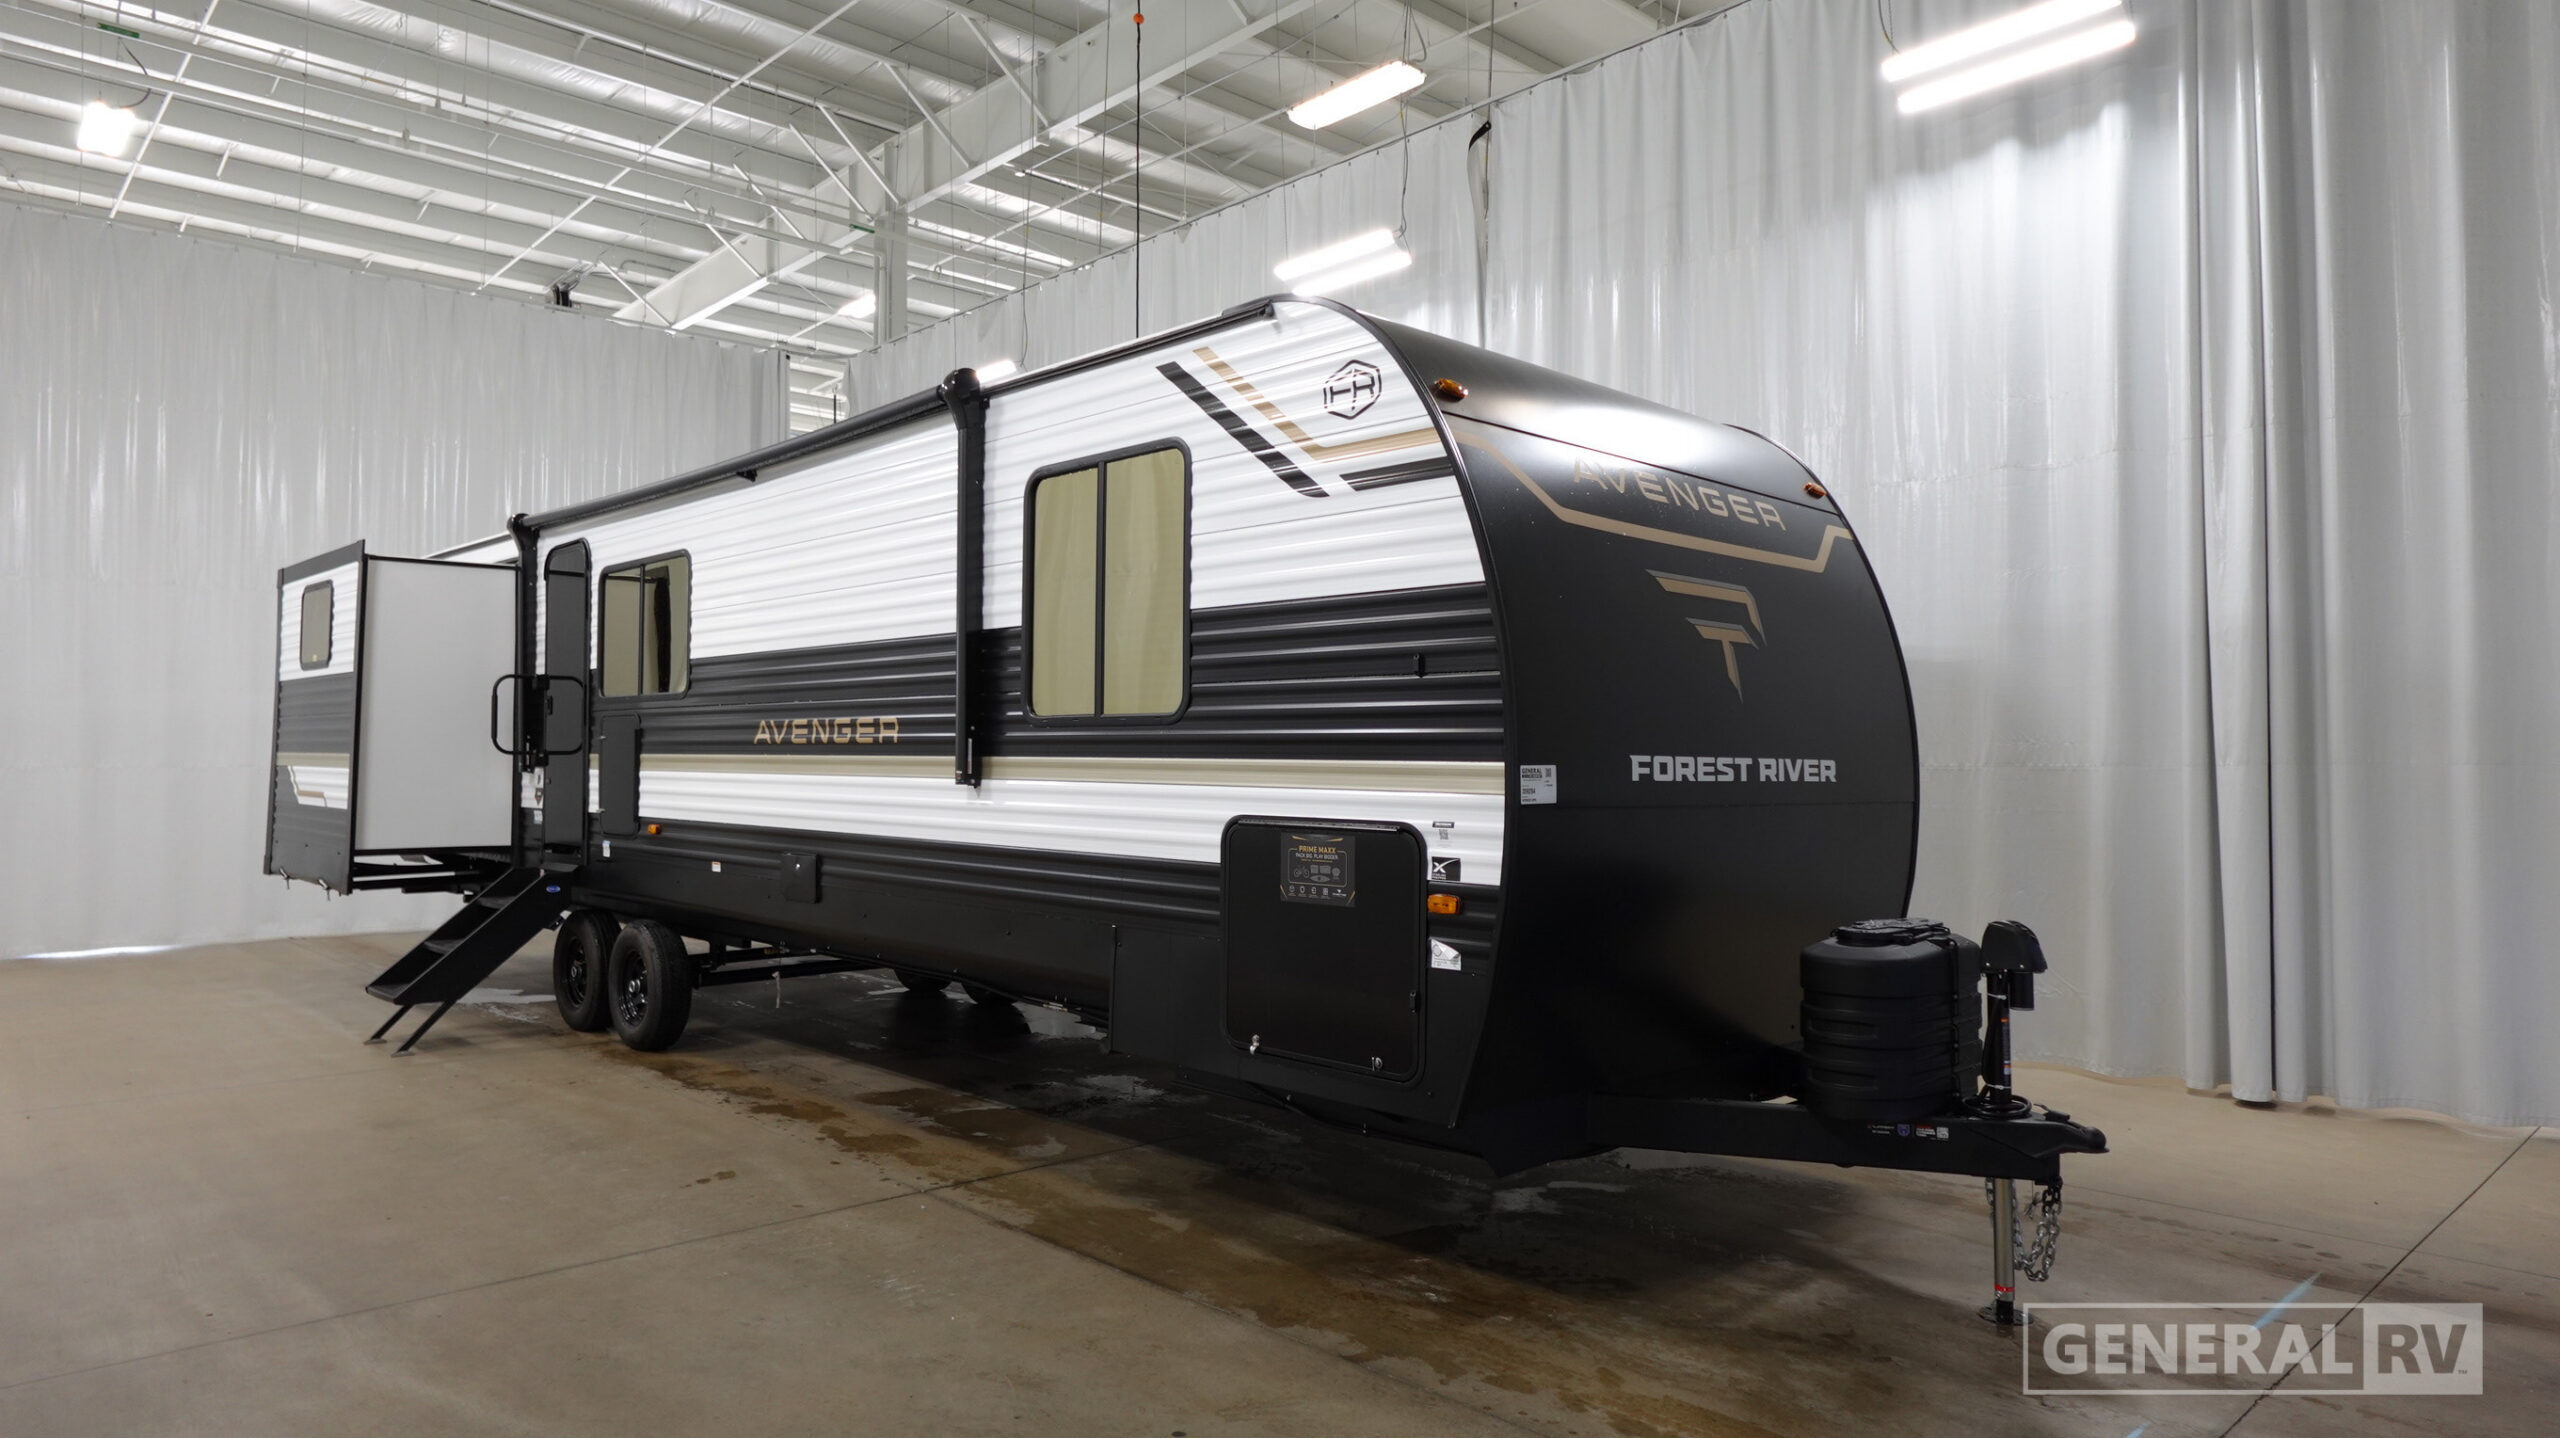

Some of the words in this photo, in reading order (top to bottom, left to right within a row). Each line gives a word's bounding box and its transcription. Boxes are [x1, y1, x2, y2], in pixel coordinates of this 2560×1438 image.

[1573, 457, 1787, 531] AVENGER
[754, 717, 899, 745] AVENGER
[1629, 755, 1753, 782] FOREST
[1757, 758, 1837, 783] RIVER
[1298, 845, 1318, 853] PRIME
